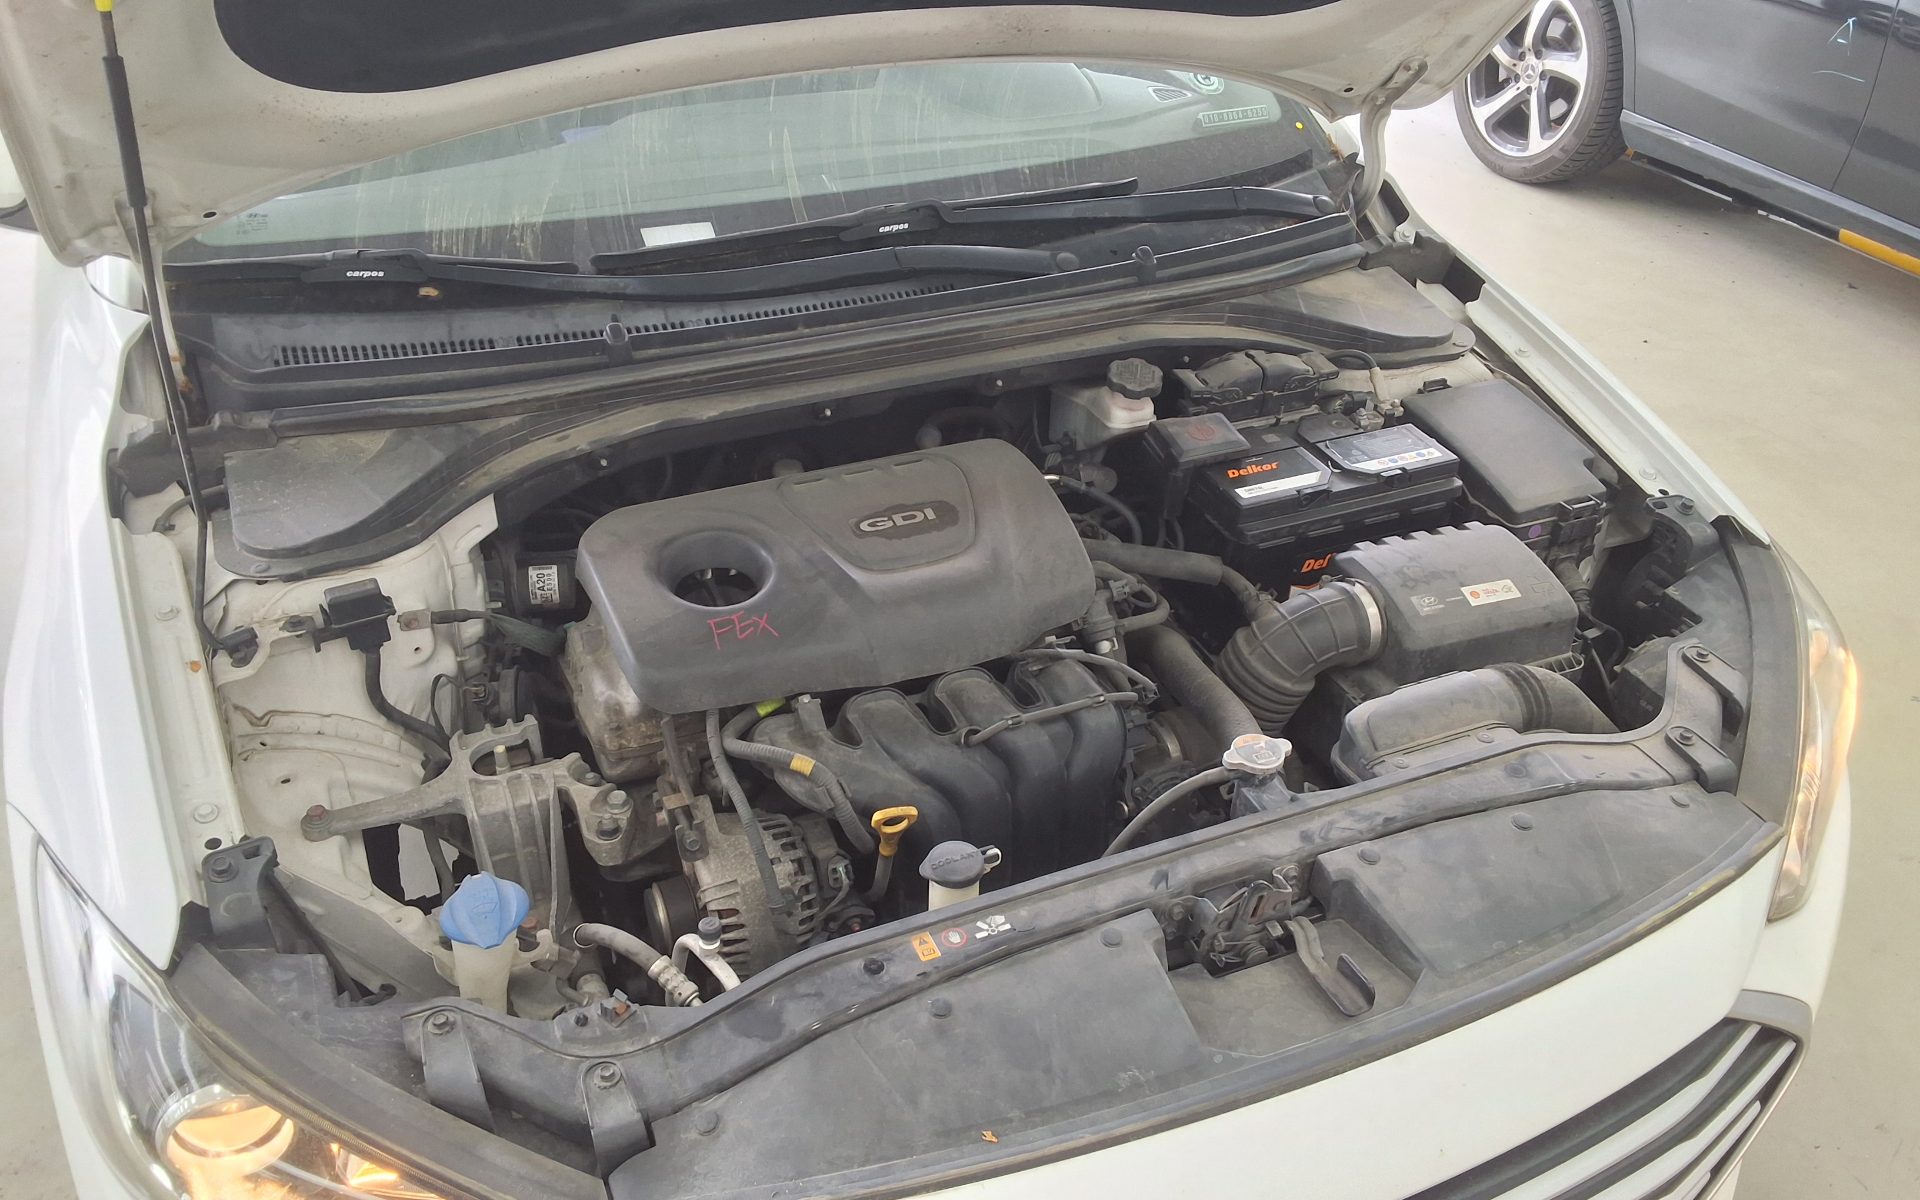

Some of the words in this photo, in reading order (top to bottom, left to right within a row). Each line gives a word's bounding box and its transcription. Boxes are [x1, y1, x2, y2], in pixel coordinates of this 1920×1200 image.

[878, 222, 909, 233] carpos
[346, 270, 384, 279] carpos
[1227, 461, 1280, 479] Delkor
[860, 508, 937, 532] GDI
[1301, 553, 1335, 573] Del
[536, 573, 546, 592] A20
